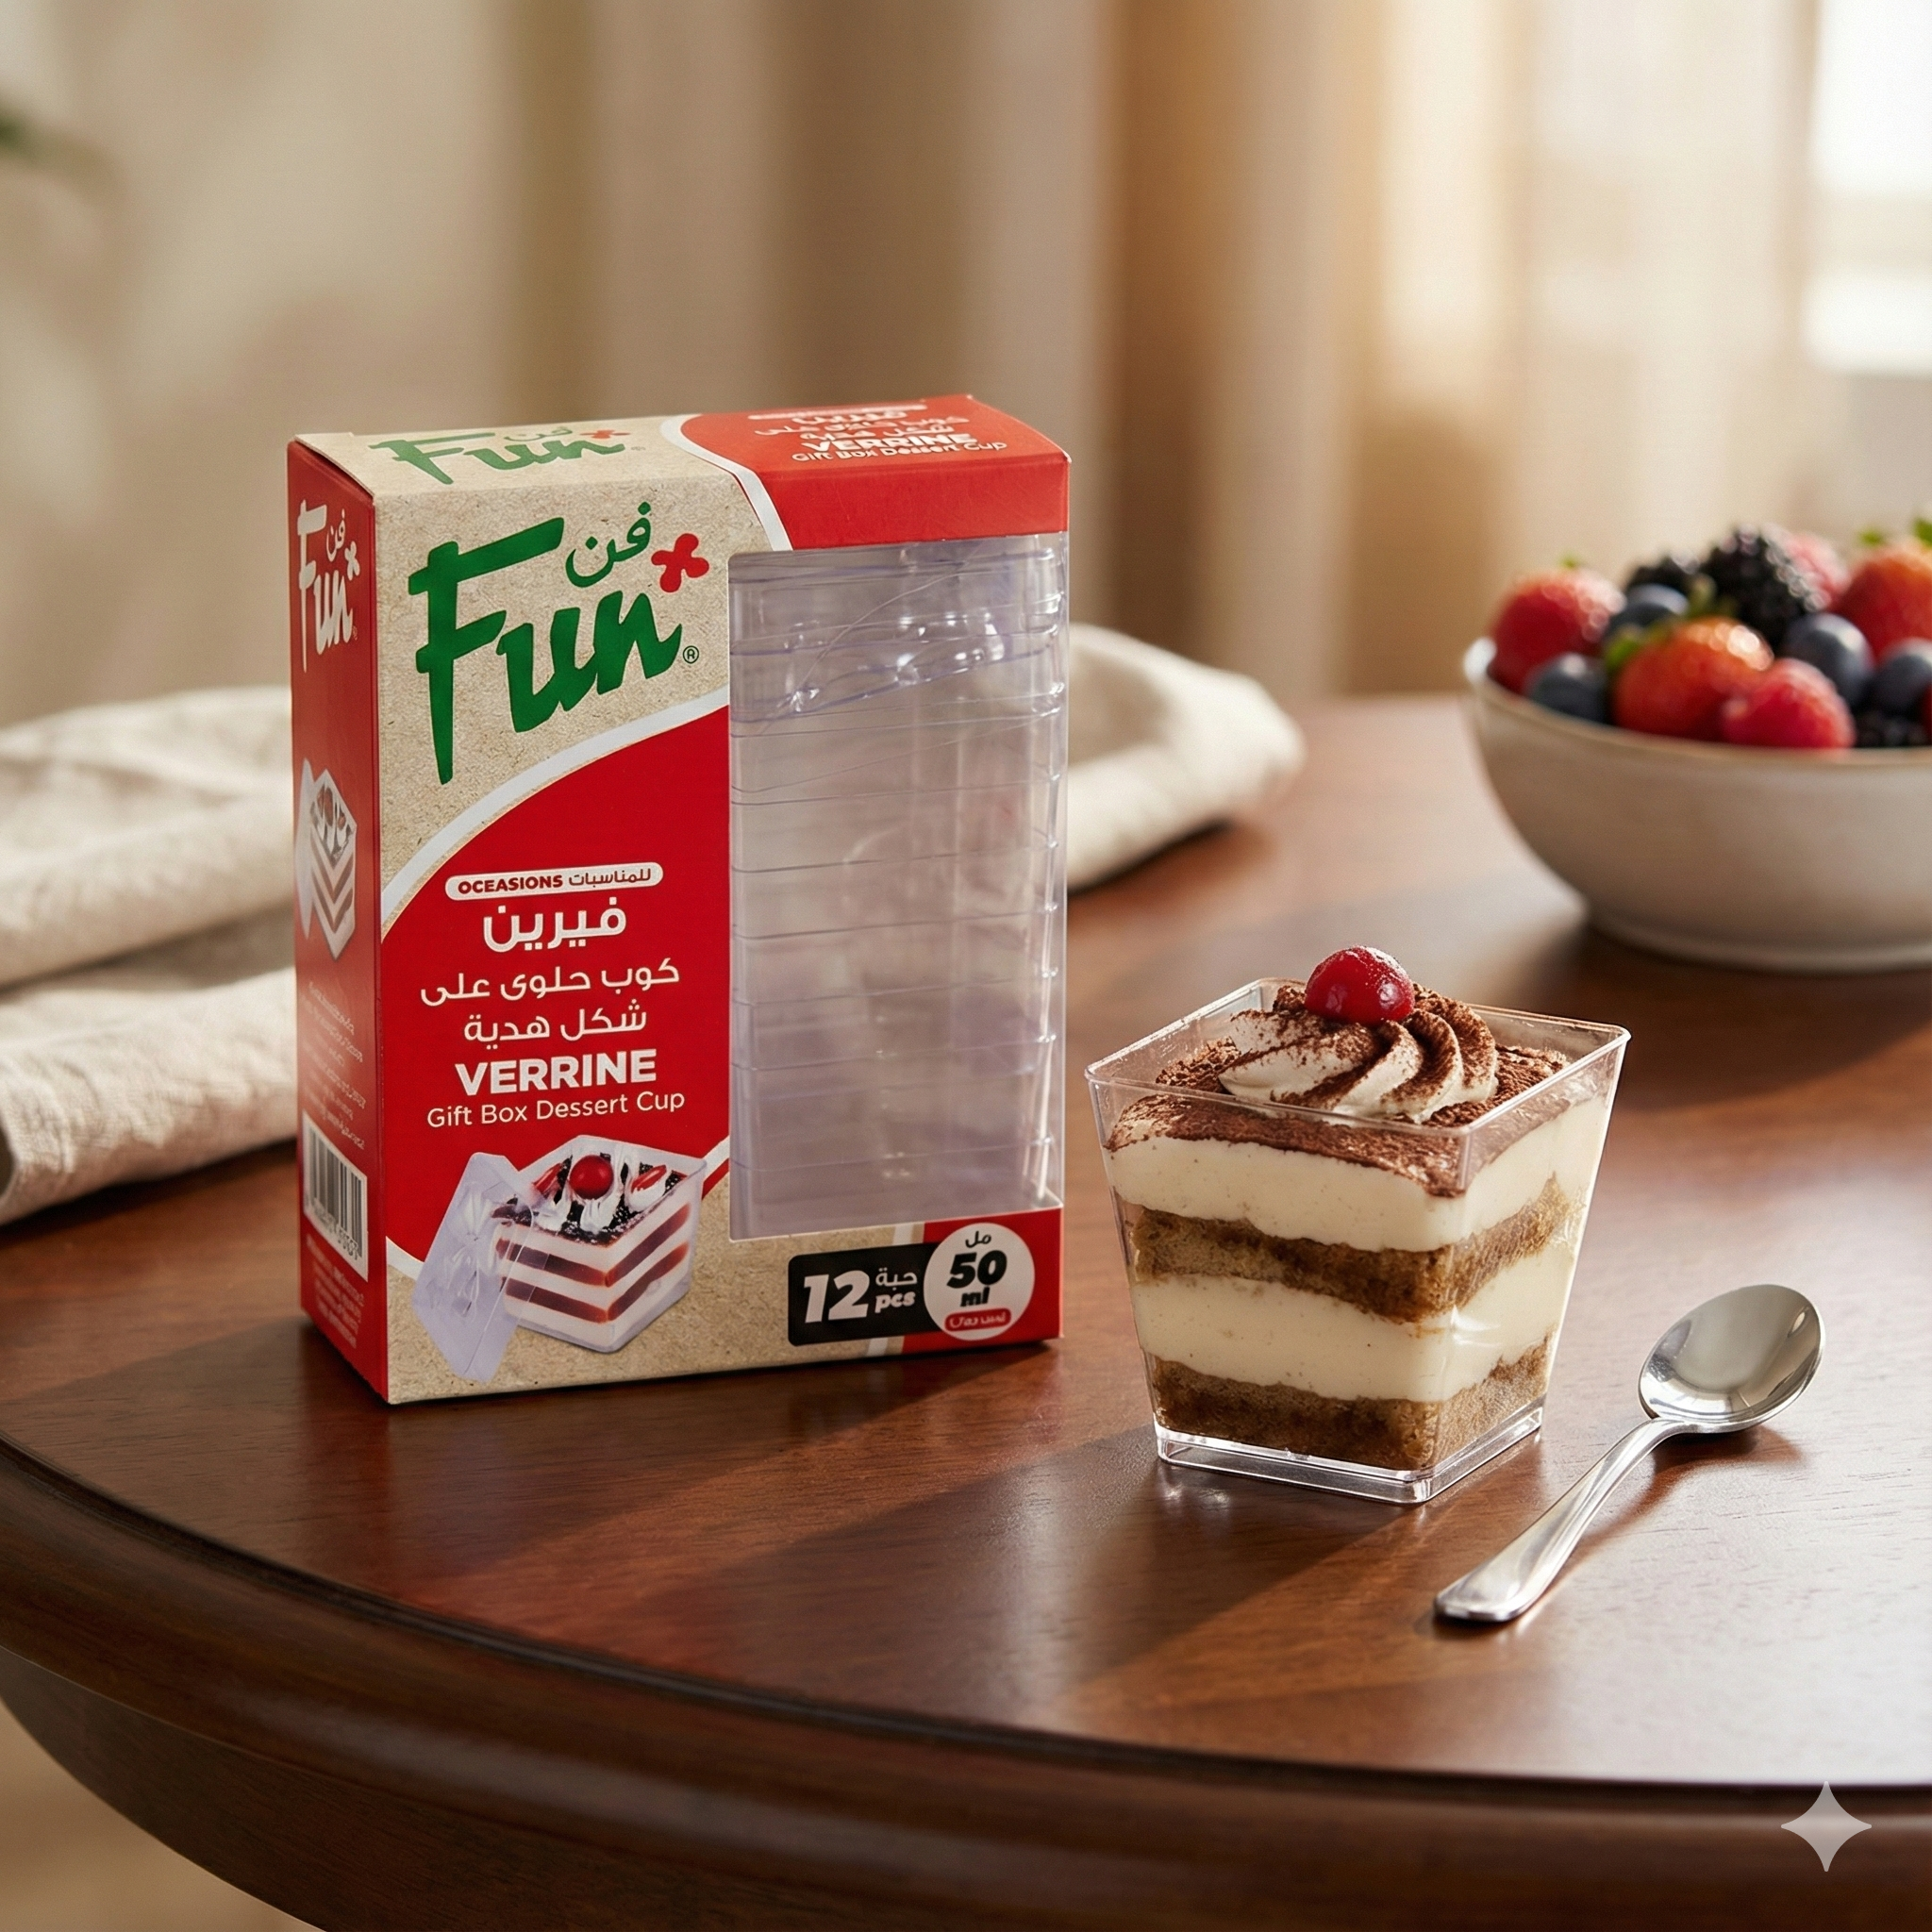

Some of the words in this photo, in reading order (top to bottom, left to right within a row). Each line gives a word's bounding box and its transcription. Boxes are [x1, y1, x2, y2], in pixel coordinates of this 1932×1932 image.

[368, 432, 625, 485] Fun
[801, 433, 978, 453] VERRINE
[963, 441, 1008, 452] Cup
[326, 508, 346, 562] فن
[565, 501, 652, 588] فن
[297, 499, 354, 674] Fun
[408, 516, 682, 785] Fun
[458, 874, 563, 894] OCEASIONS
[568, 868, 651, 888] للمناسبات
[483, 896, 627, 953] فيرين
[420, 973, 491, 1007] على
[500, 966, 591, 1001] حلوى
[601, 958, 680, 994] كوب
[463, 1013, 550, 1050] هدية
[559, 998, 647, 1041] شكل
[454, 1048, 658, 1096] VERRINE
[427, 1106, 473, 1128] Gift
[481, 1104, 528, 1124] Box
[536, 1093, 628, 1120] Dessert
[637, 1091, 686, 1112] Cup
[964, 1230, 991, 1248] مل
[874, 1267, 918, 1291] حبة
[946, 1249, 1008, 1290] 50
[804, 1270, 870, 1324] 12
[874, 1291, 916, 1314] pcs
[959, 1286, 991, 1307] ml
